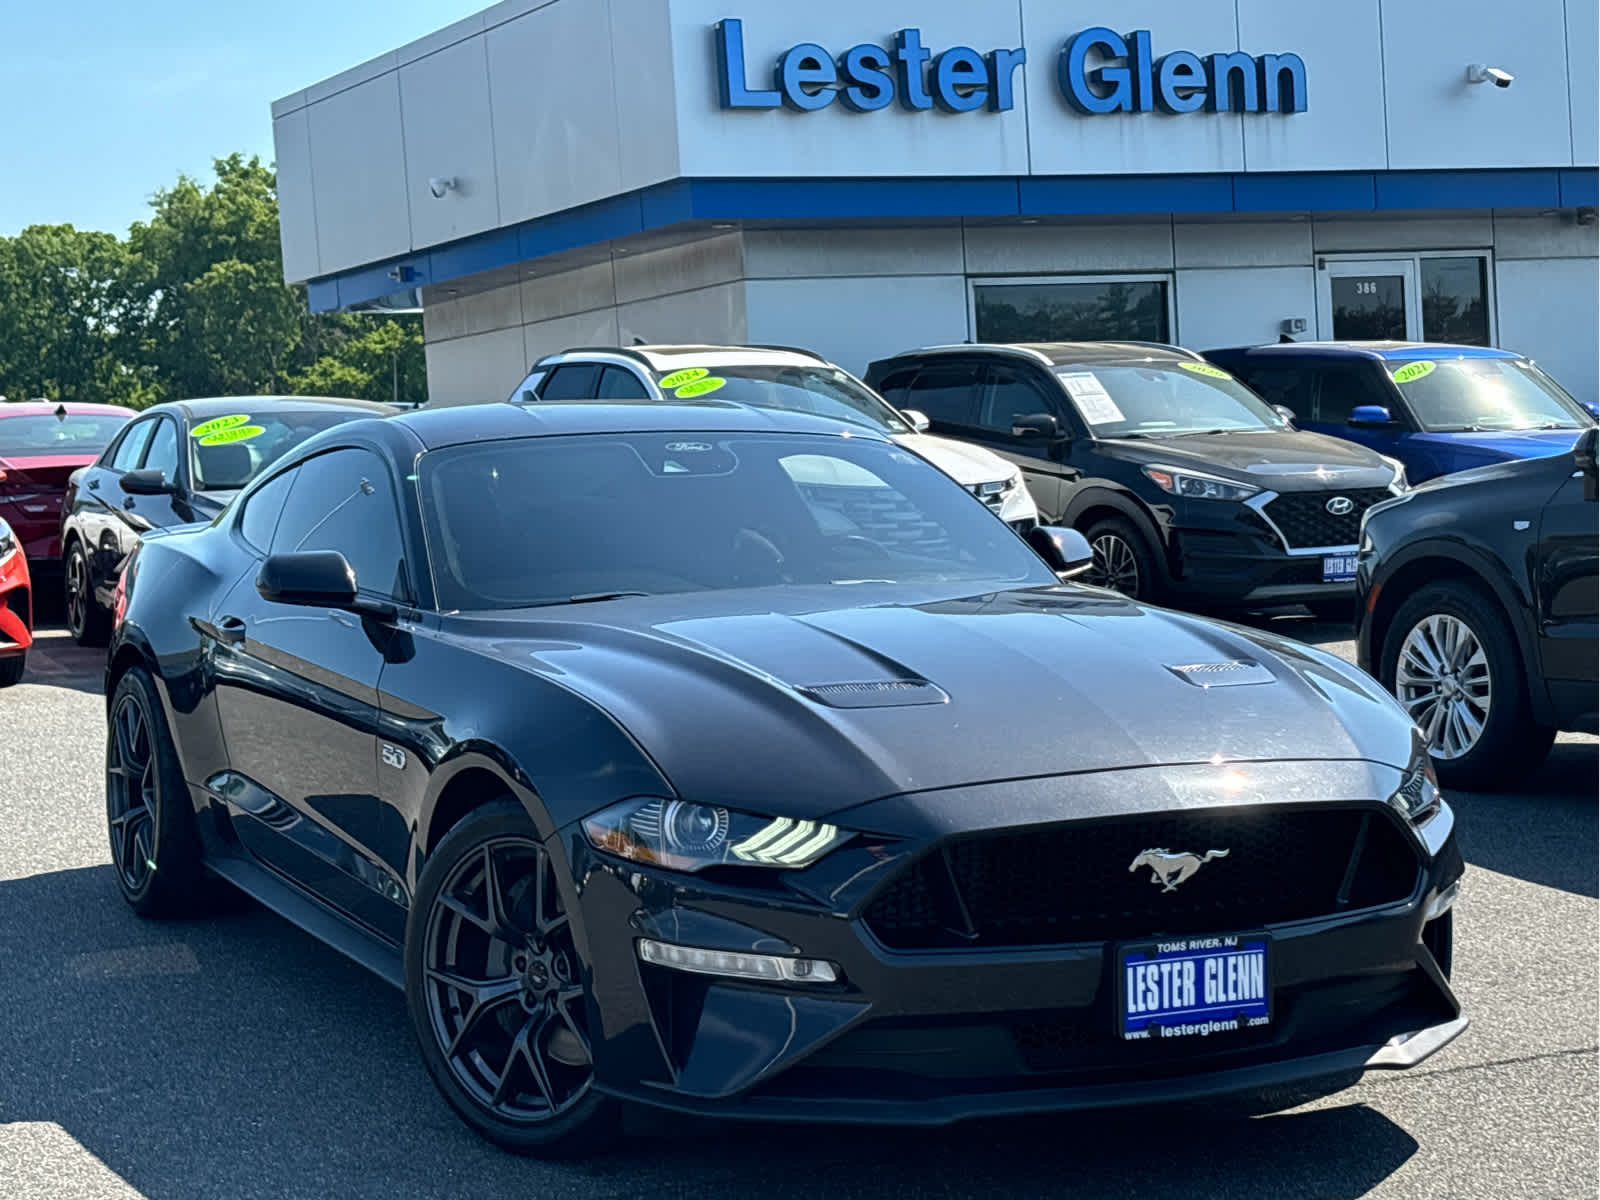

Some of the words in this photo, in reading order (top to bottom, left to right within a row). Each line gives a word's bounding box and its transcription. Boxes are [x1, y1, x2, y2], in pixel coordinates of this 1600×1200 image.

[715, 18, 1026, 115] Lester
[1060, 26, 1308, 115] Glenn
[1356, 282, 1377, 294] 386
[670, 370, 699, 385] 2024
[1400, 362, 1428, 379] 2021
[1157, 942, 1187, 953] TOMS
[1224, 936, 1239, 946] NJ
[1127, 961, 1196, 1013] LESTER
[1204, 953, 1264, 1004] GLENN
[1161, 1020, 1238, 1037] lesterglenn
